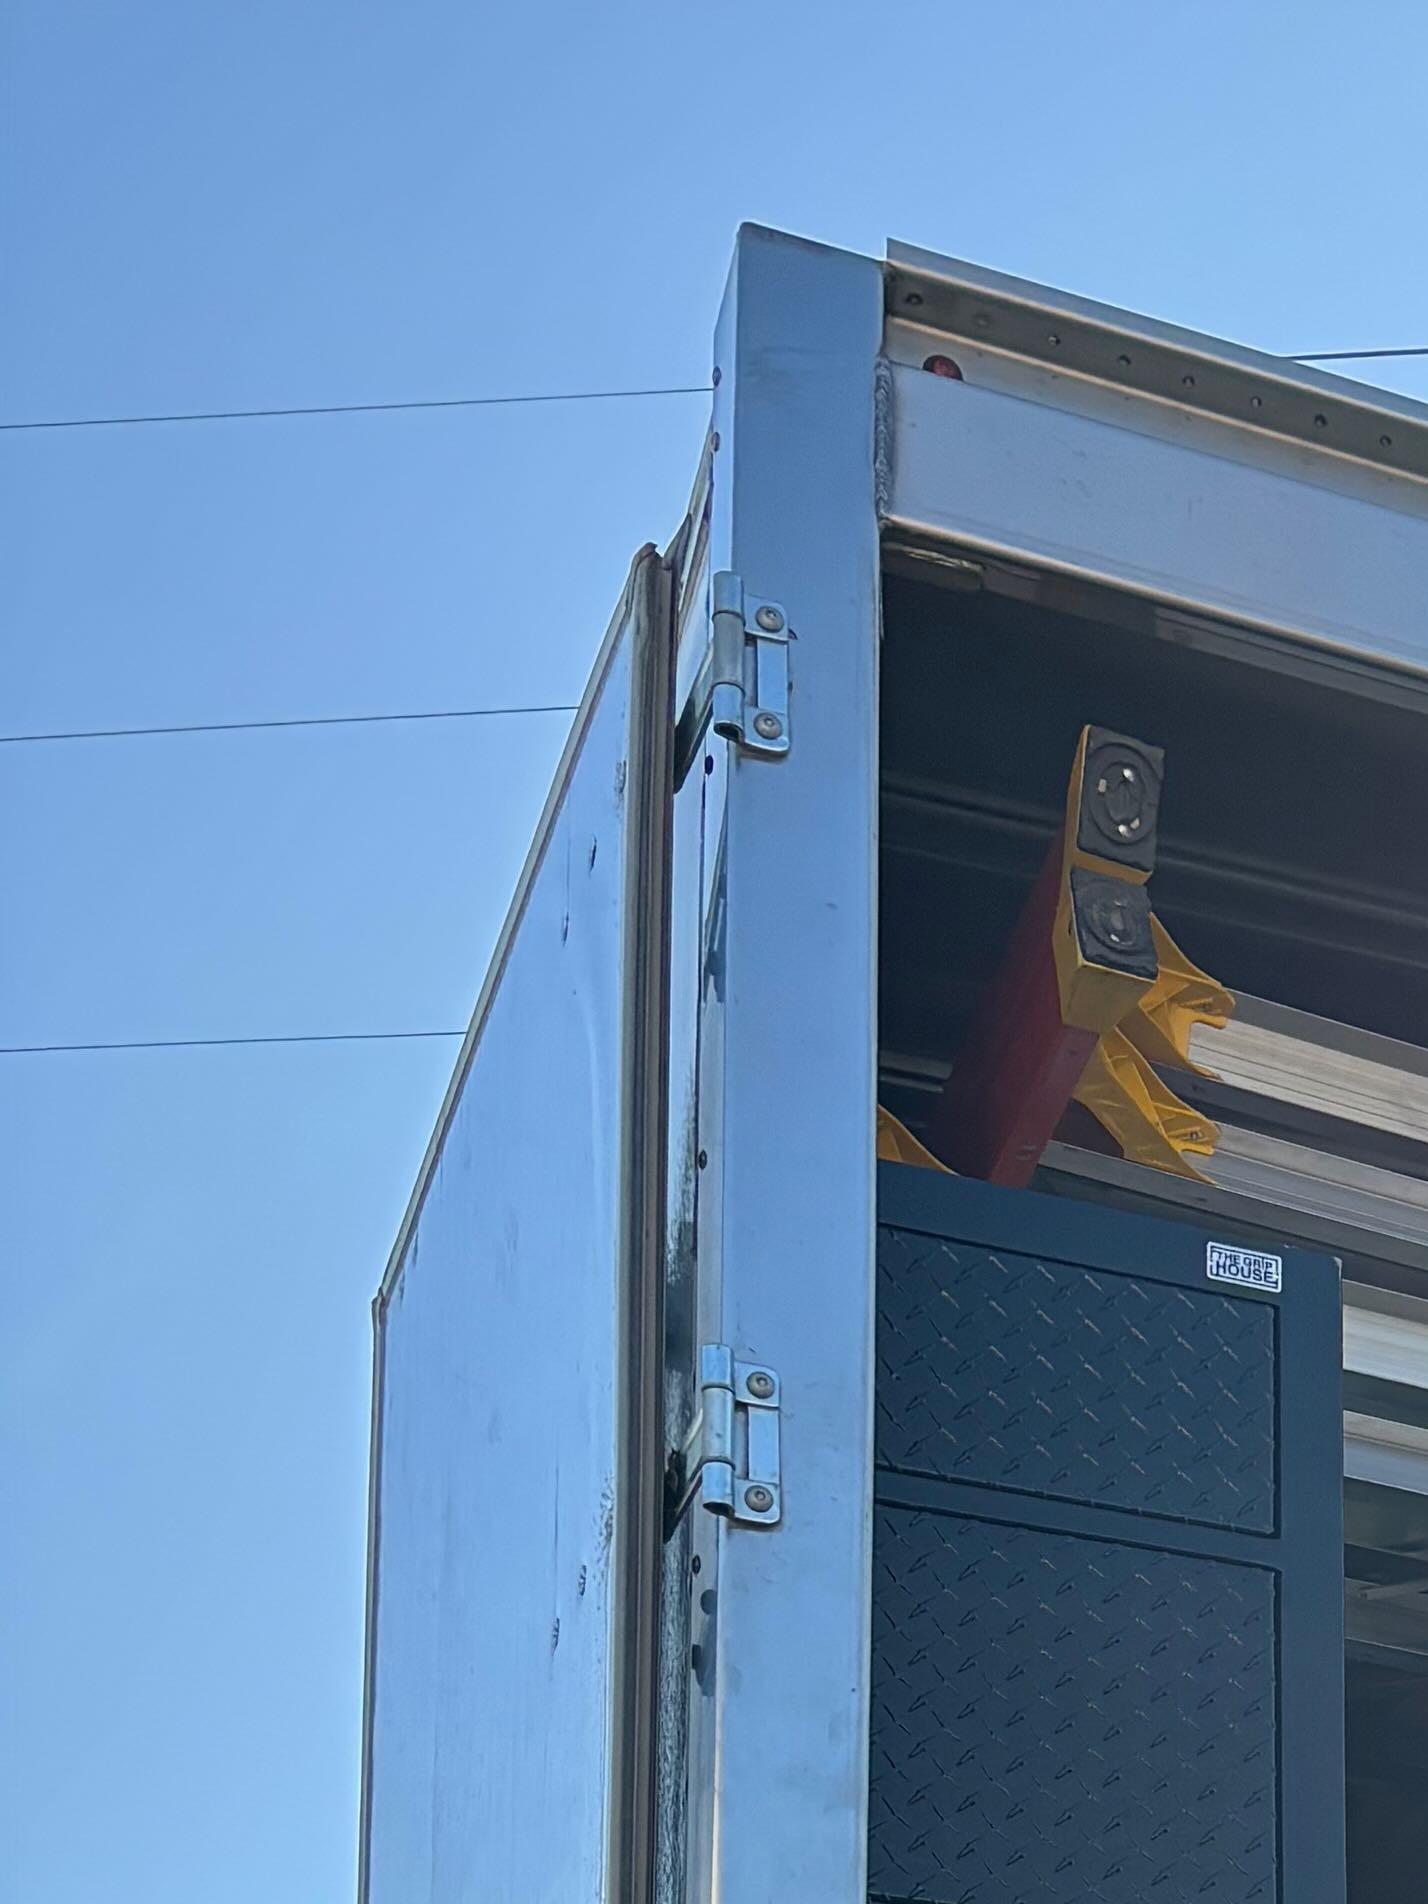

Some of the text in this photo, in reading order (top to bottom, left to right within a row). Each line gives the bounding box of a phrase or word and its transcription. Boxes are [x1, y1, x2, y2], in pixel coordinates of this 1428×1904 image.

[1214, 1251, 1273, 1270] THE GRIP
[1215, 1260, 1277, 1283] HOUSE
